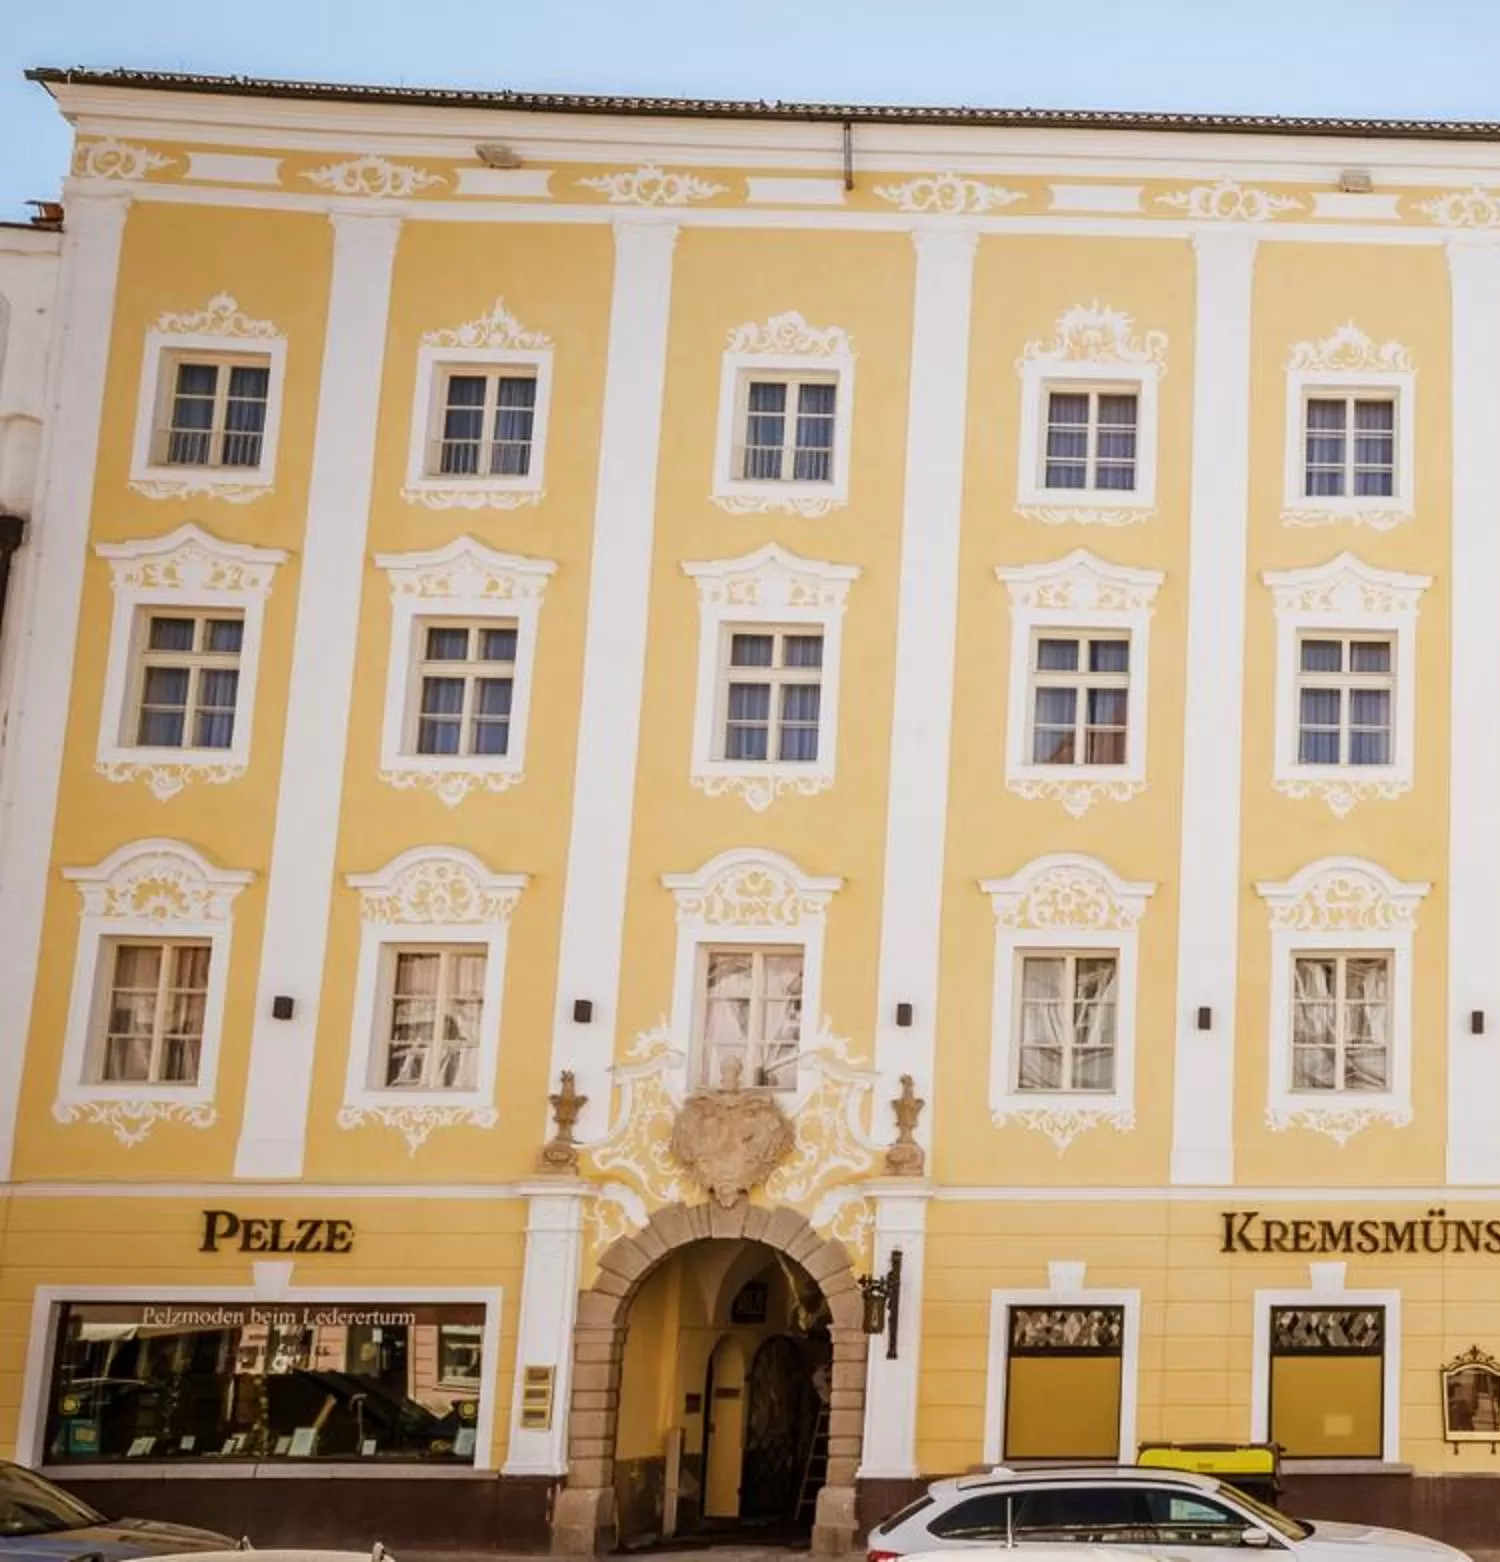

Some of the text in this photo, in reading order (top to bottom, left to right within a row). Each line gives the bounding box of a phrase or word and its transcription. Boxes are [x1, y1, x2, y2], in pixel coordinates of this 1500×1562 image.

[199, 1210, 353, 1252] PELZE
[143, 1306, 416, 1325] Pelzmoden beim Ledererturm
